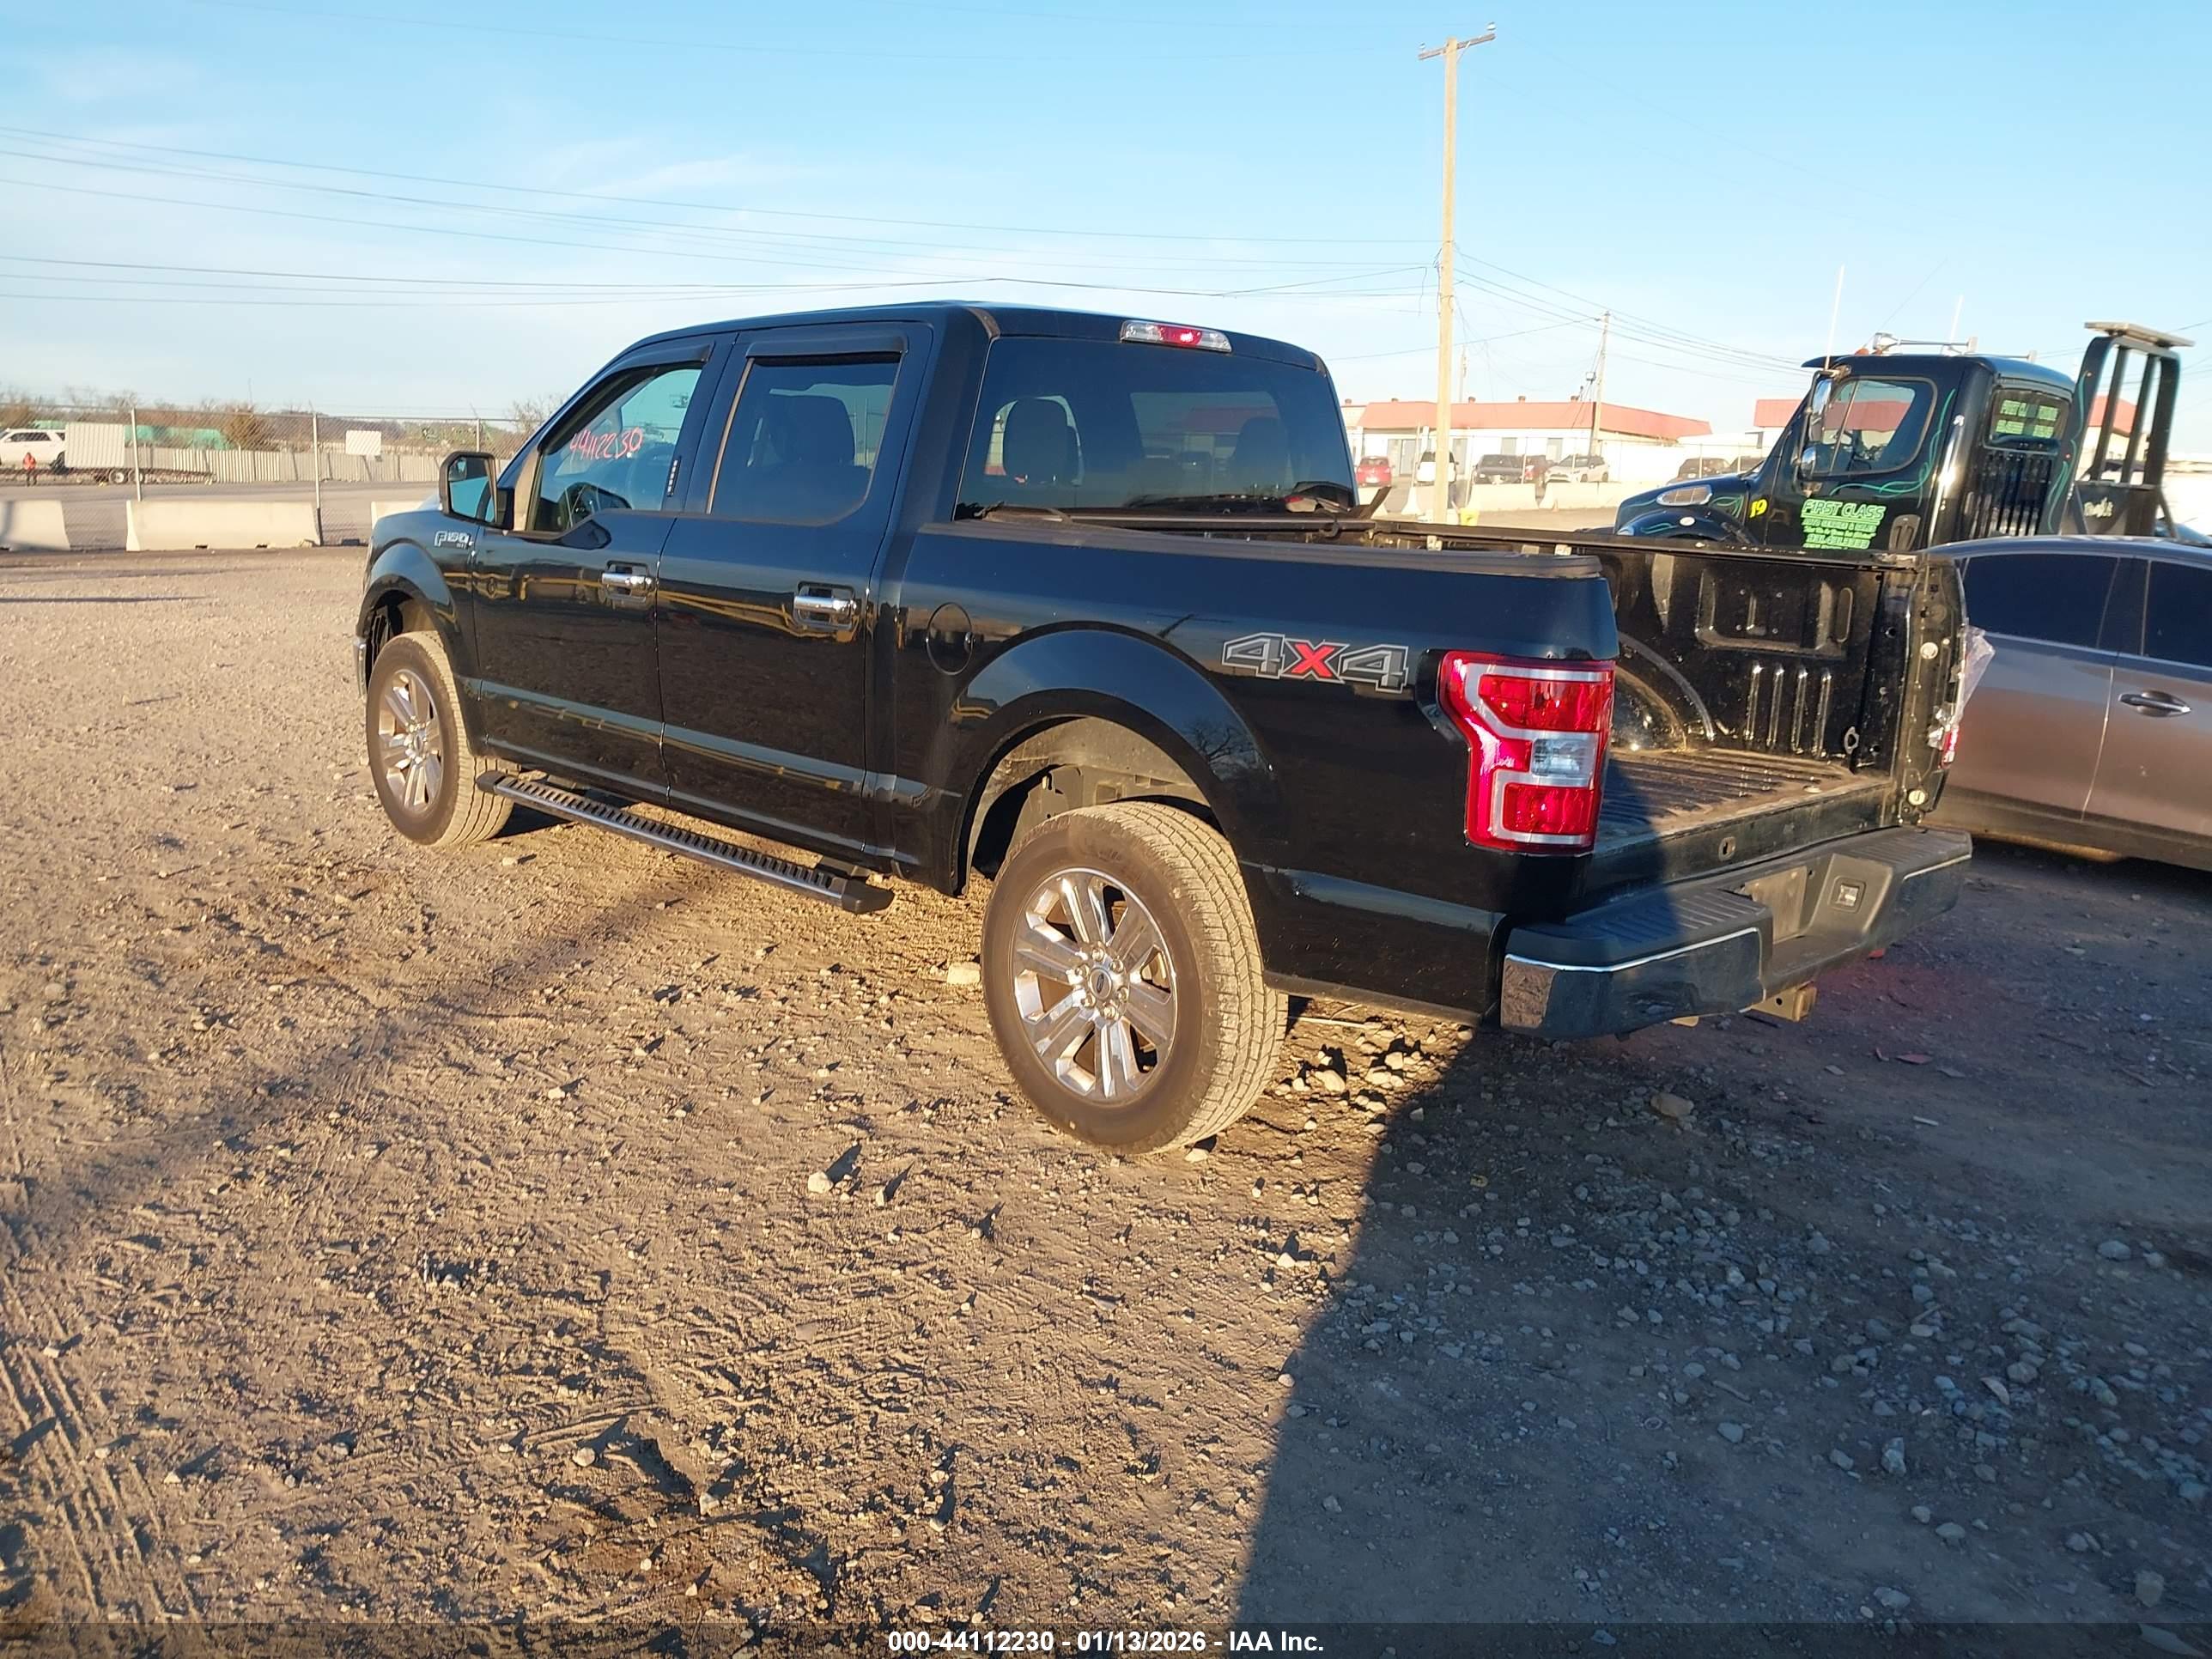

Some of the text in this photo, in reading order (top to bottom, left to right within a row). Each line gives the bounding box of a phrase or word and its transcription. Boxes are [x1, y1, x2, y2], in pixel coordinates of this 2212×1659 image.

[569, 426, 644, 460] 44112230
[1749, 498, 1768, 518] 19
[1802, 499, 1887, 520] FIRST CLASS
